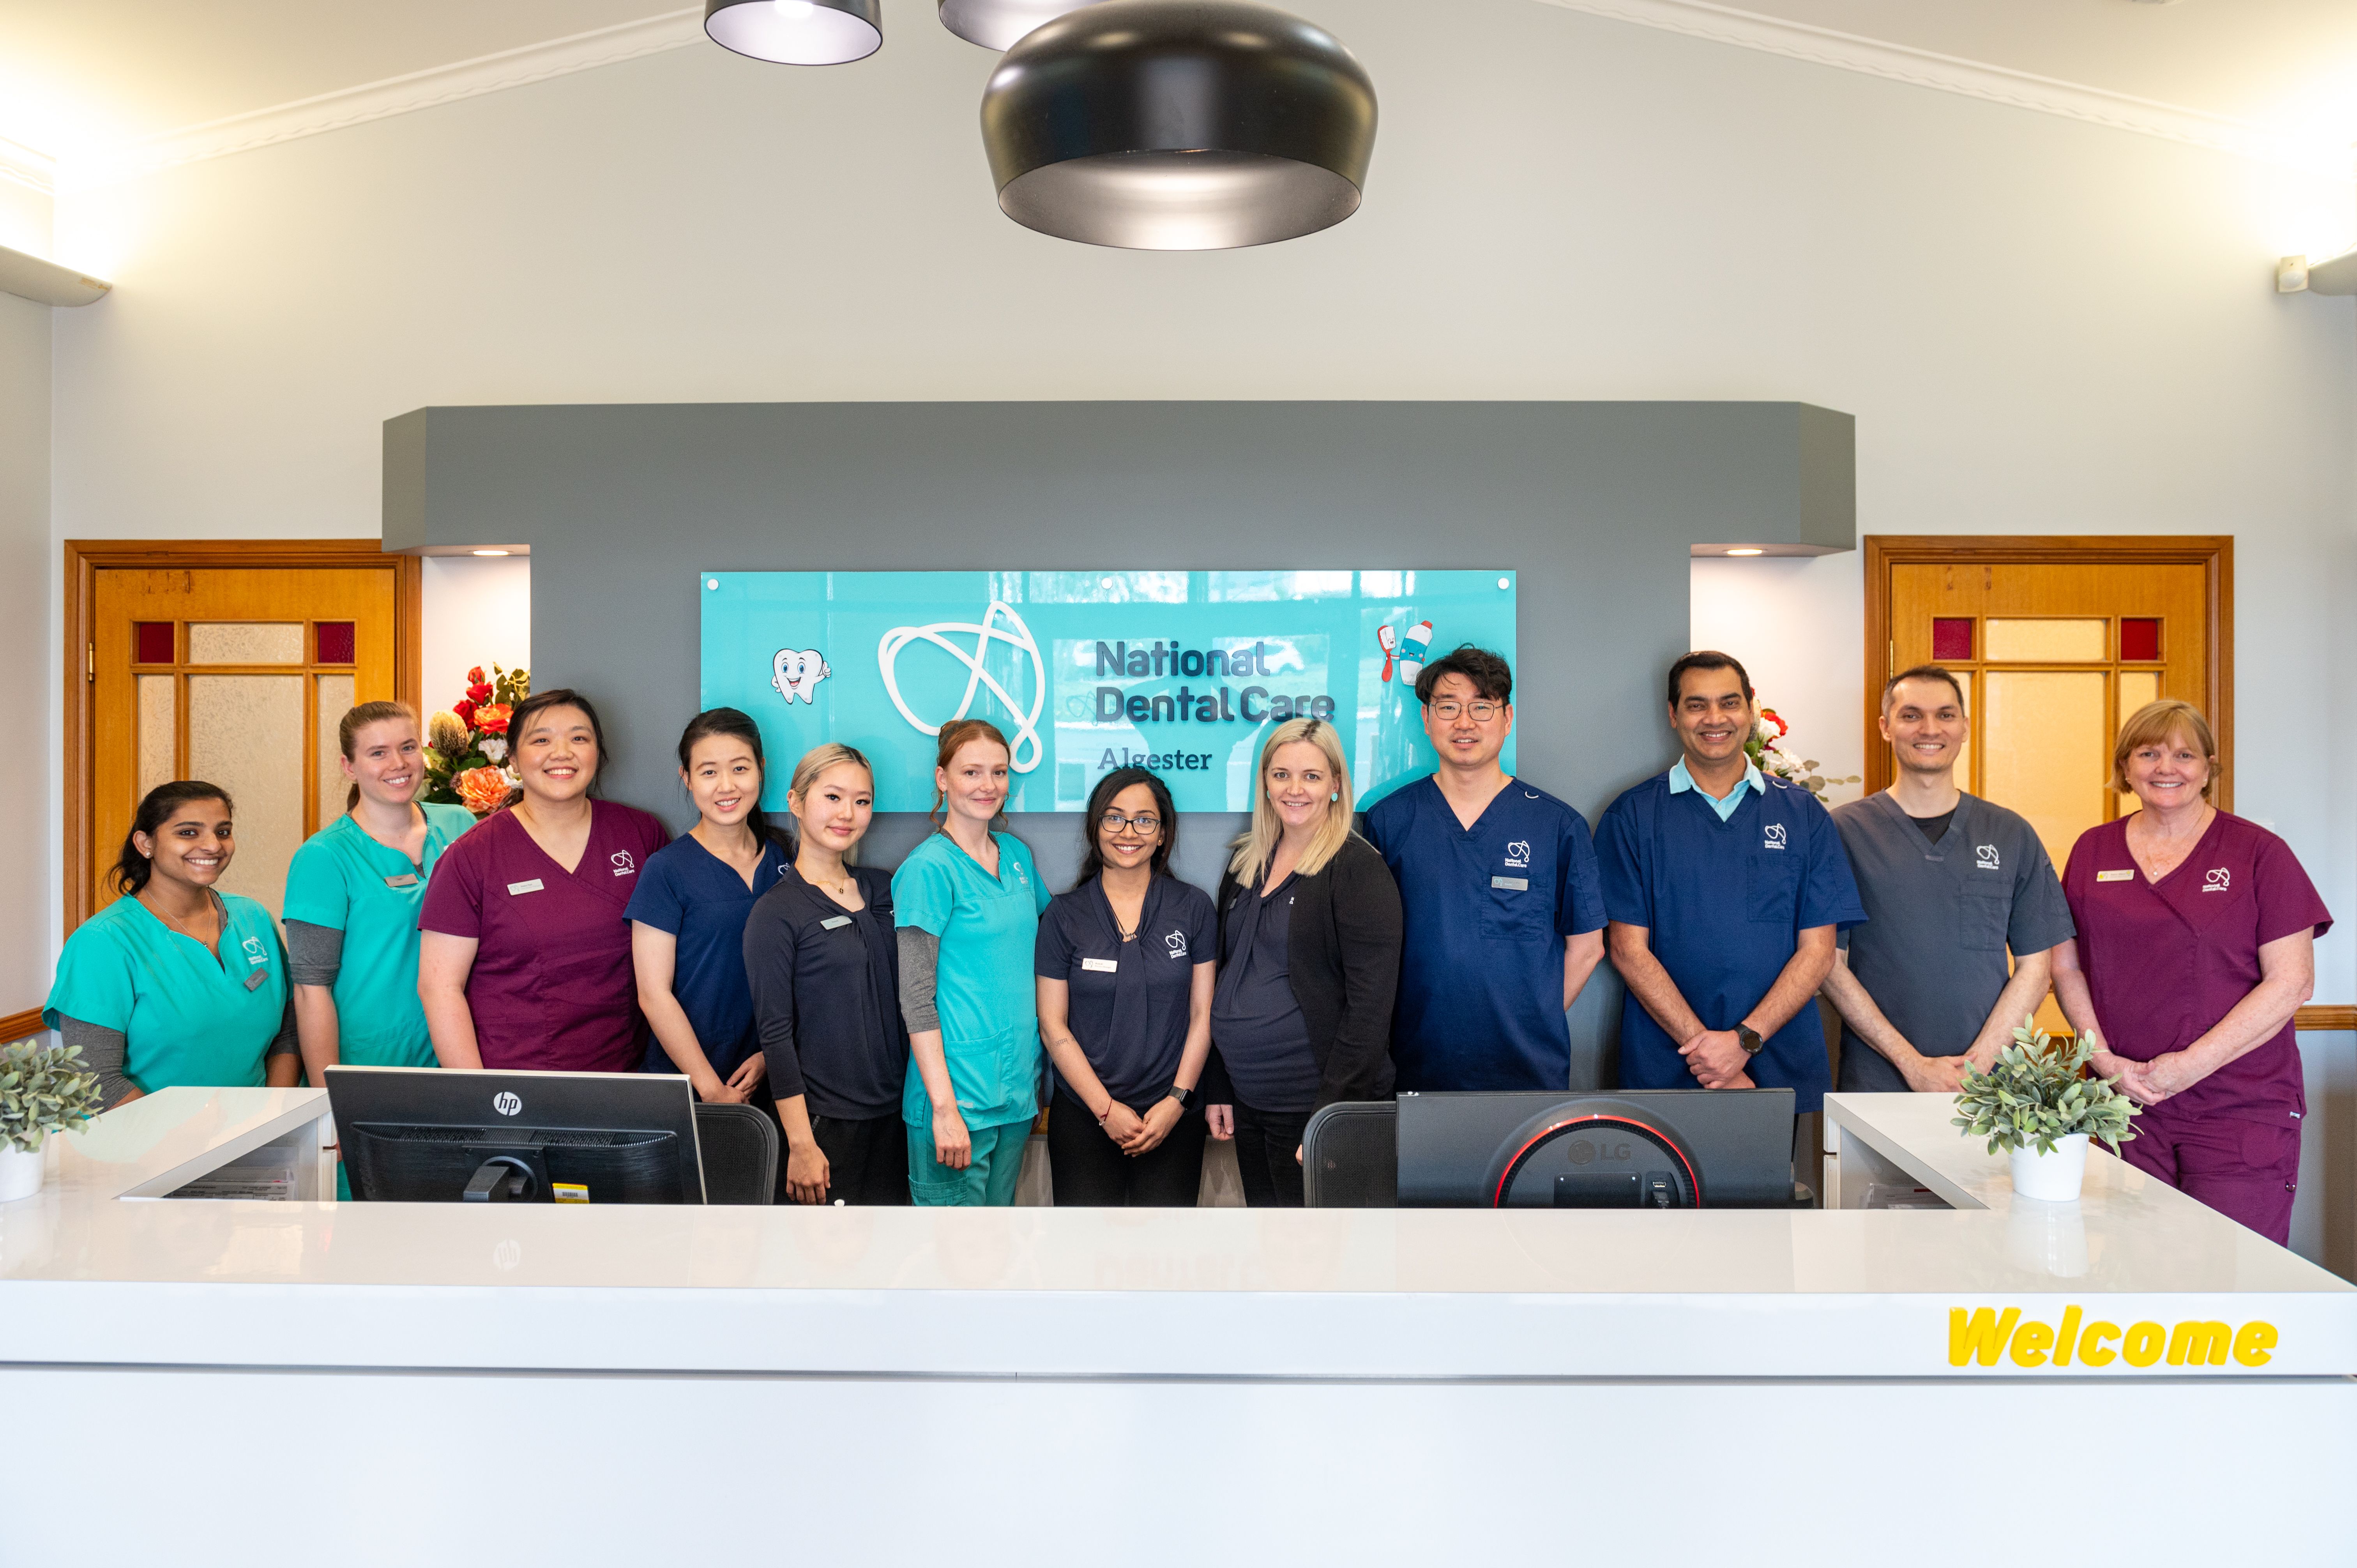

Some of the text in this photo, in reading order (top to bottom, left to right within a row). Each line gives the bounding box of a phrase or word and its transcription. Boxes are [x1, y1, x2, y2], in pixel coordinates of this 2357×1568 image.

[1096, 641, 1270, 676] National
[1096, 686, 1335, 722] Dental Care
[1097, 747, 1213, 770] Algester
[498, 1091, 518, 1116] hp
[1601, 1143, 1631, 1160] LG
[1948, 1304, 2278, 1367] Welcome
